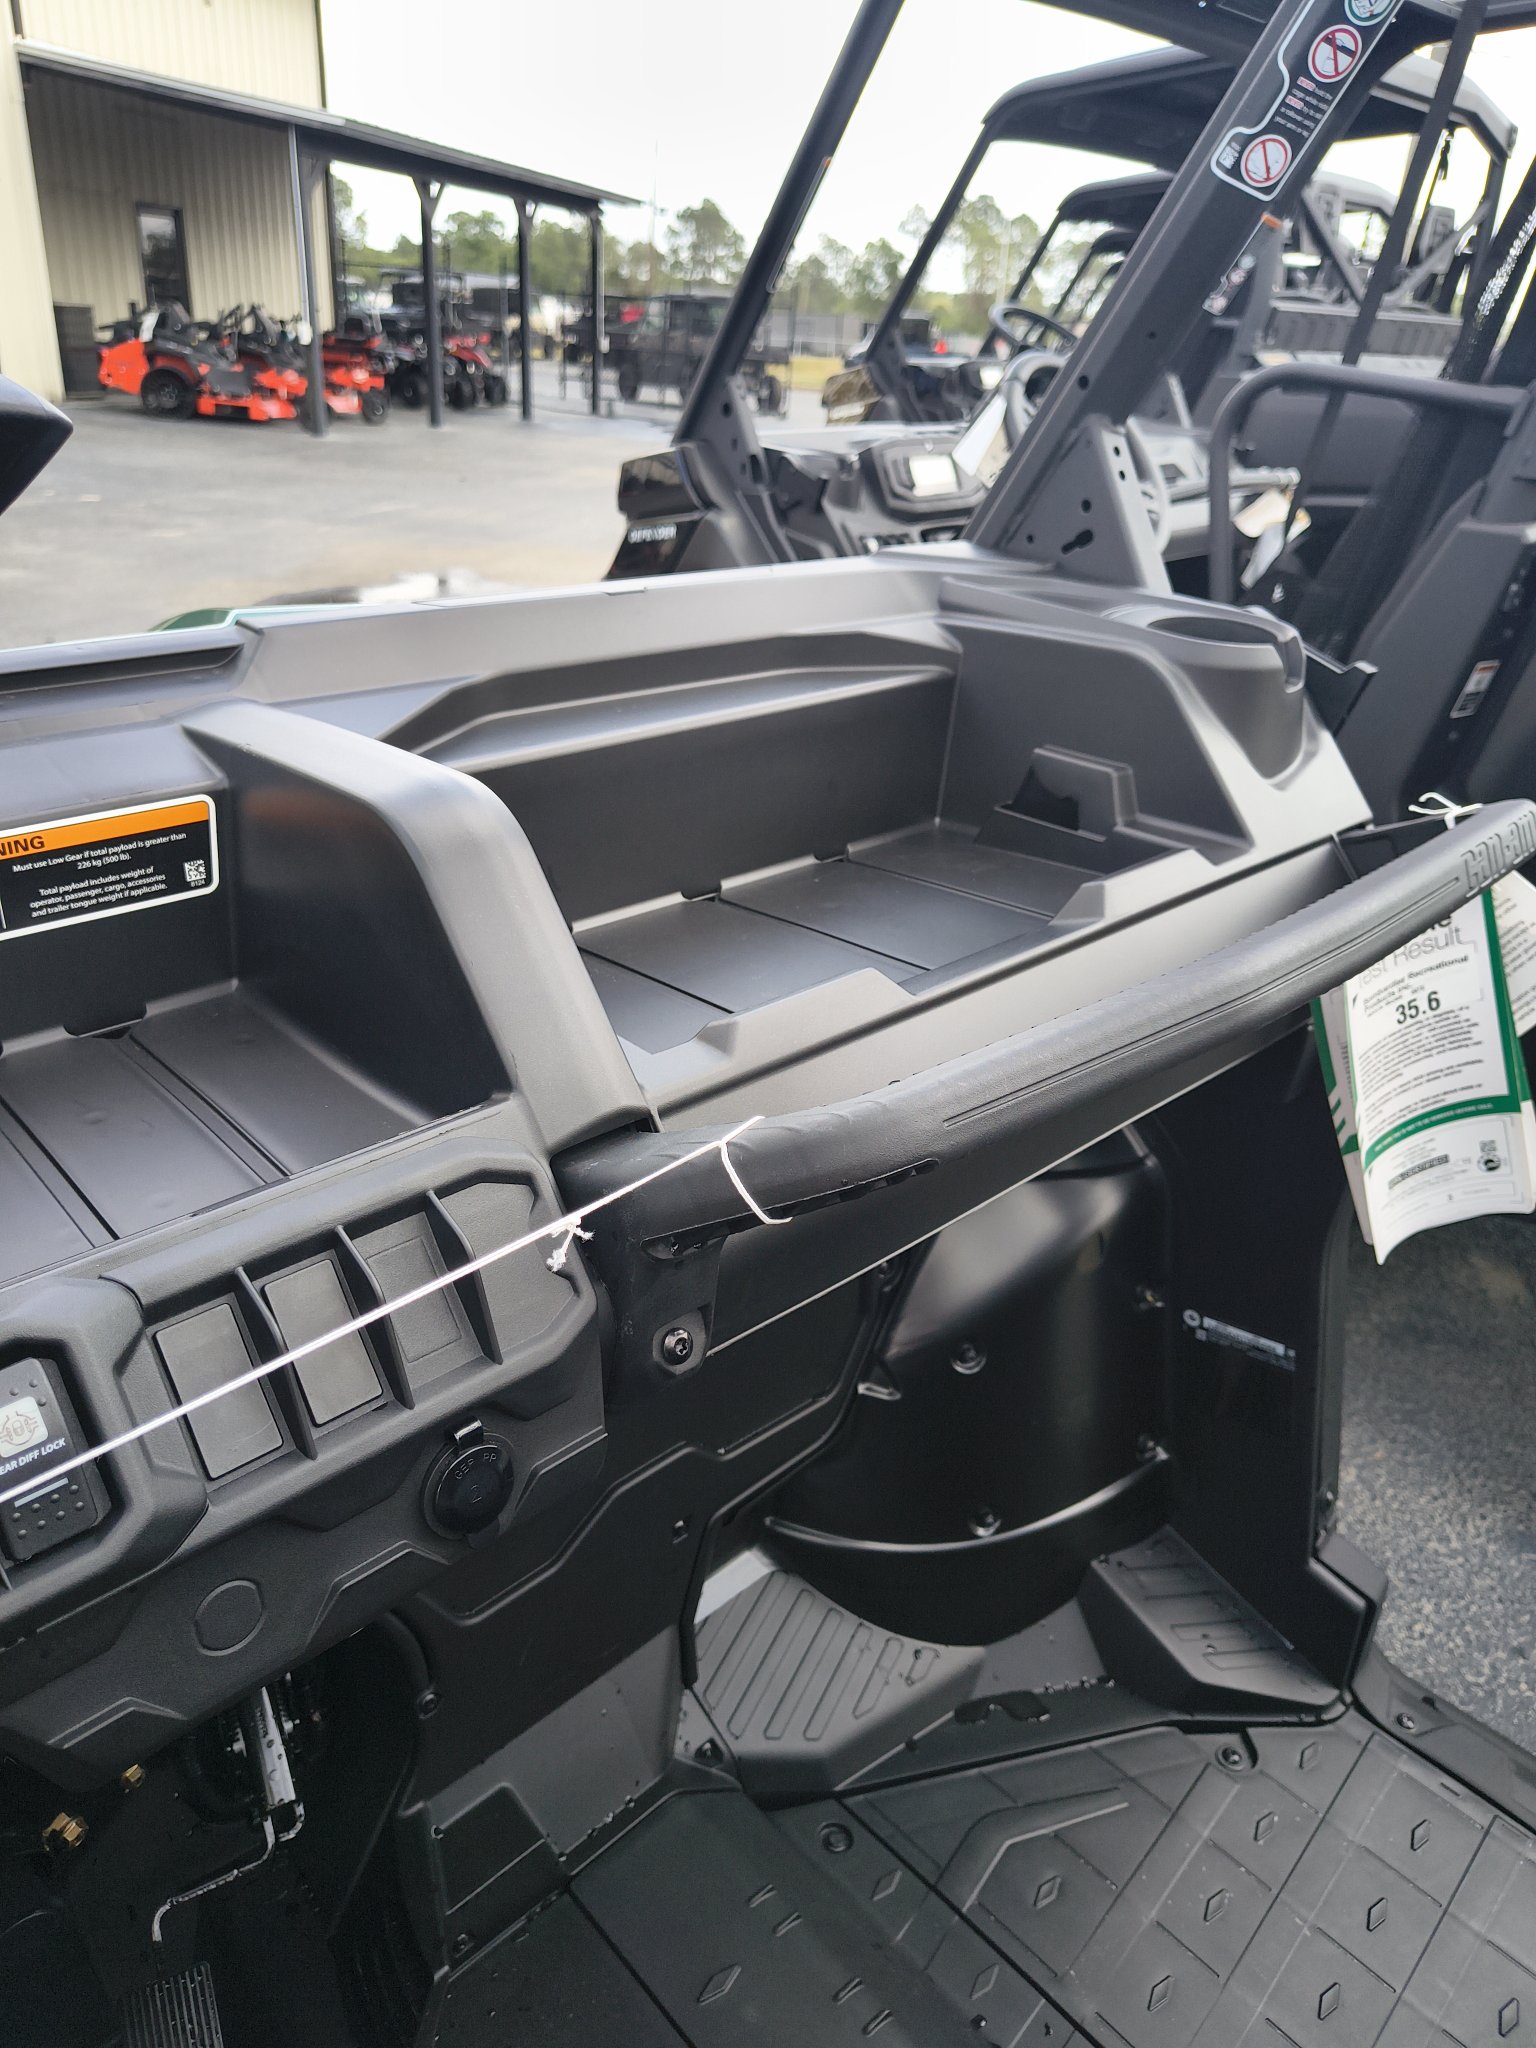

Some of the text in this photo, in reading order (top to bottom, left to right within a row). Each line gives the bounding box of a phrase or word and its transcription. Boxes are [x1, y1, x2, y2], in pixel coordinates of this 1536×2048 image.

[12, 832, 187, 873] Must use Low Gear if total payload is greater than
[77, 861, 91, 870] 226
[91, 858, 102, 867] kg
[102, 855, 119, 865] (500
[30, 874, 166, 909] operator, passenger, cargo, accessories
[39, 866, 154, 896] Total payload includes weight of
[31, 883, 168, 918] and trailer tongue weight if applicable.
[1395, 990, 1441, 1024] 35.6
[19, 1449, 40, 1466] DIFF
[41, 1437, 66, 1456] LOCK
